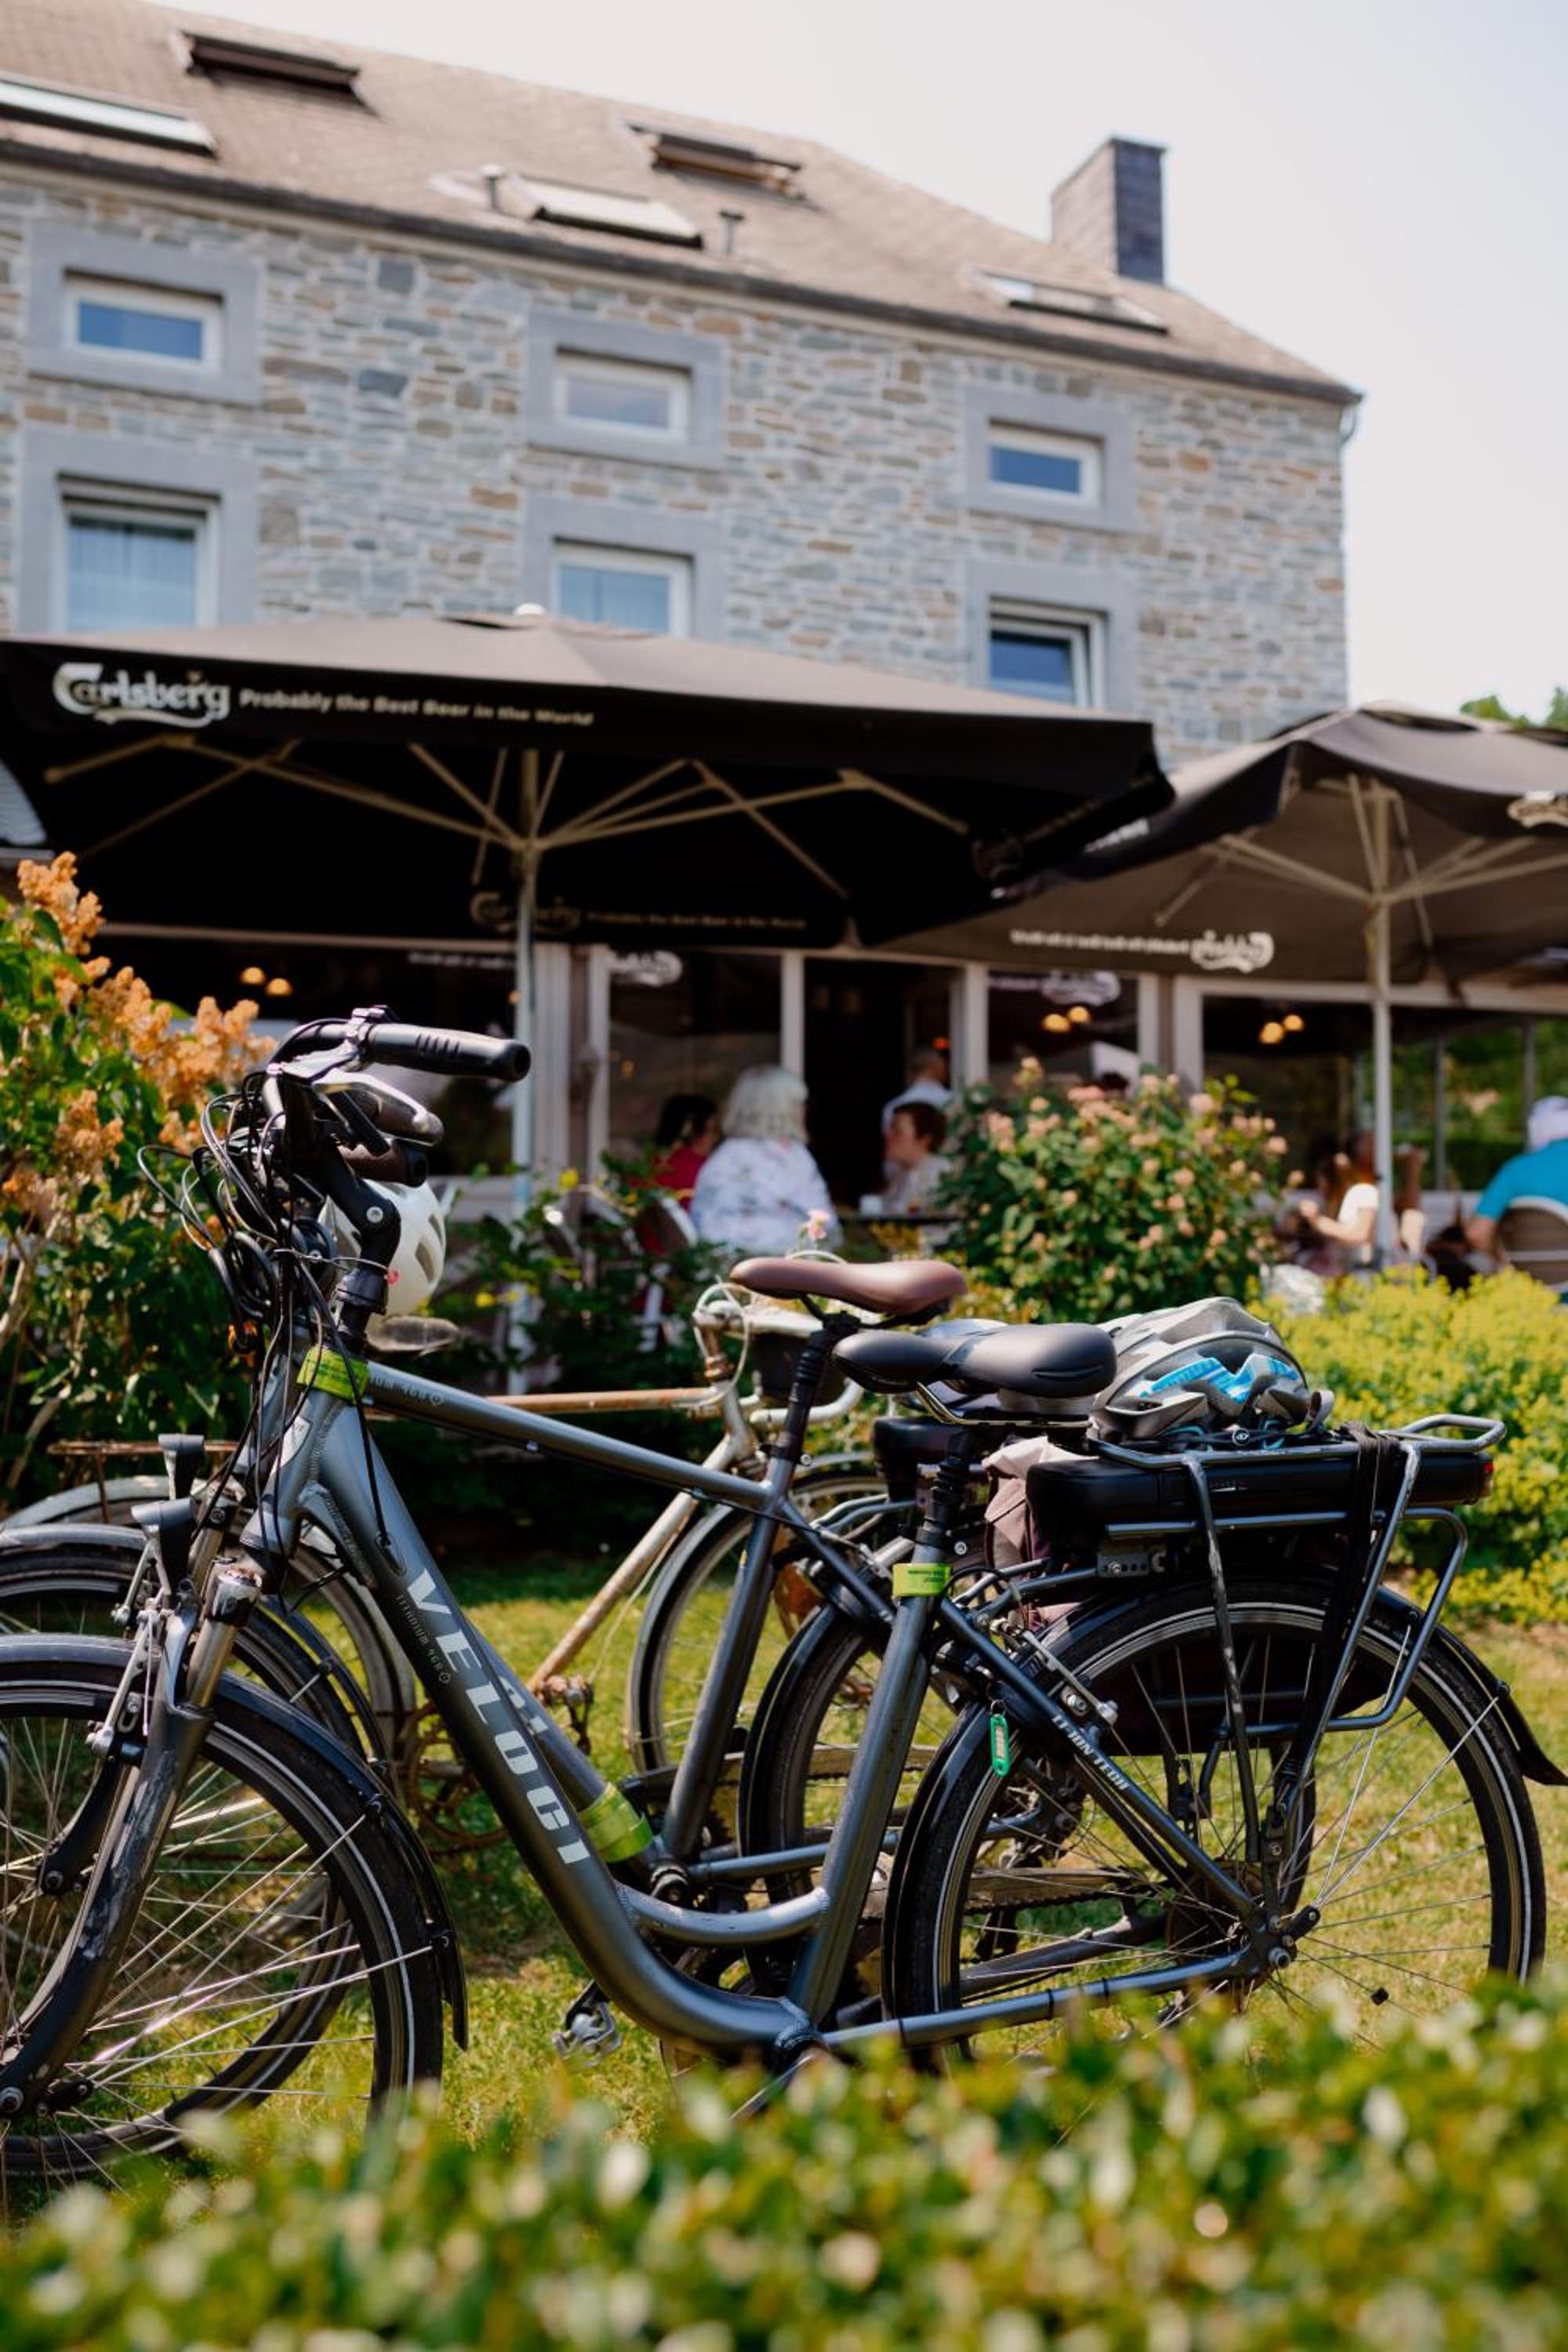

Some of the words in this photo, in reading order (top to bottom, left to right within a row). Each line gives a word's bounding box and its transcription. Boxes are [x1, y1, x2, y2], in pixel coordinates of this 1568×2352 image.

[52, 662, 231, 728] Carlsberg
[239, 688, 332, 714] Probably
[336, 692, 370, 713] the
[374, 695, 419, 714] Best
[423, 699, 470, 717] Beer
[473, 703, 495, 719] in
[497, 705, 531, 722] the
[407, 1570, 590, 1864] VELOCI
